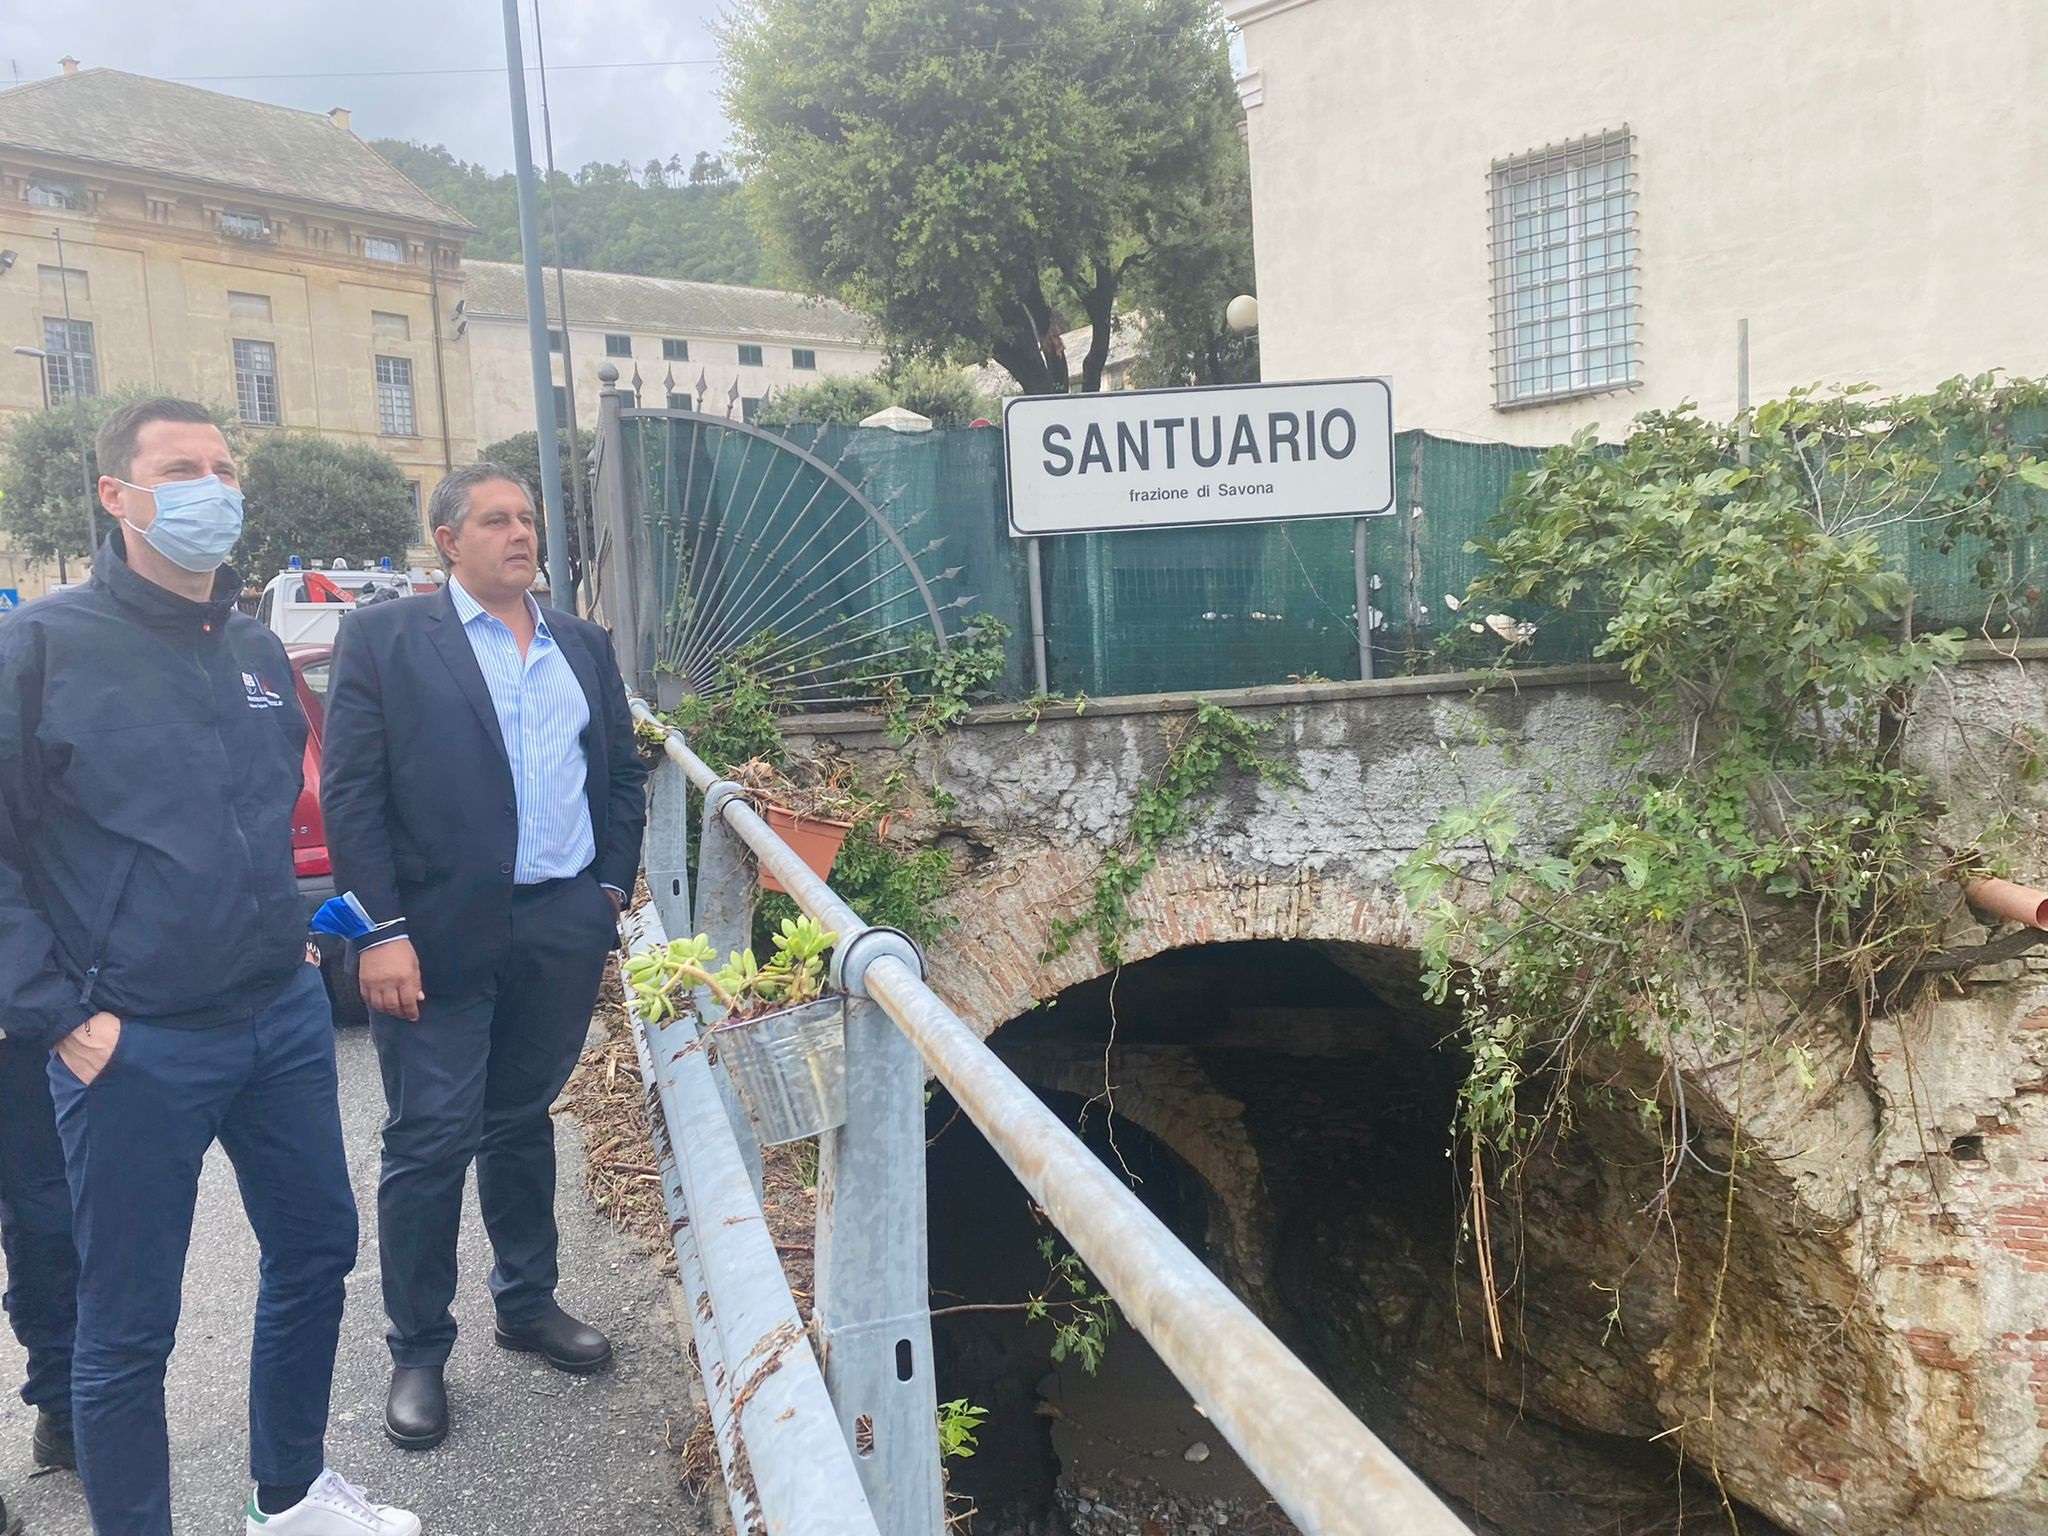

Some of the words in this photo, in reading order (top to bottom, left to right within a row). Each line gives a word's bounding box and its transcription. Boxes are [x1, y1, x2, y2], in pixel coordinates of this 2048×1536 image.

[1042, 407, 1357, 477] SANTUARIO
[1129, 488, 1189, 502] frazione
[1197, 485, 1210, 498] di
[1218, 483, 1274, 497] Savona
